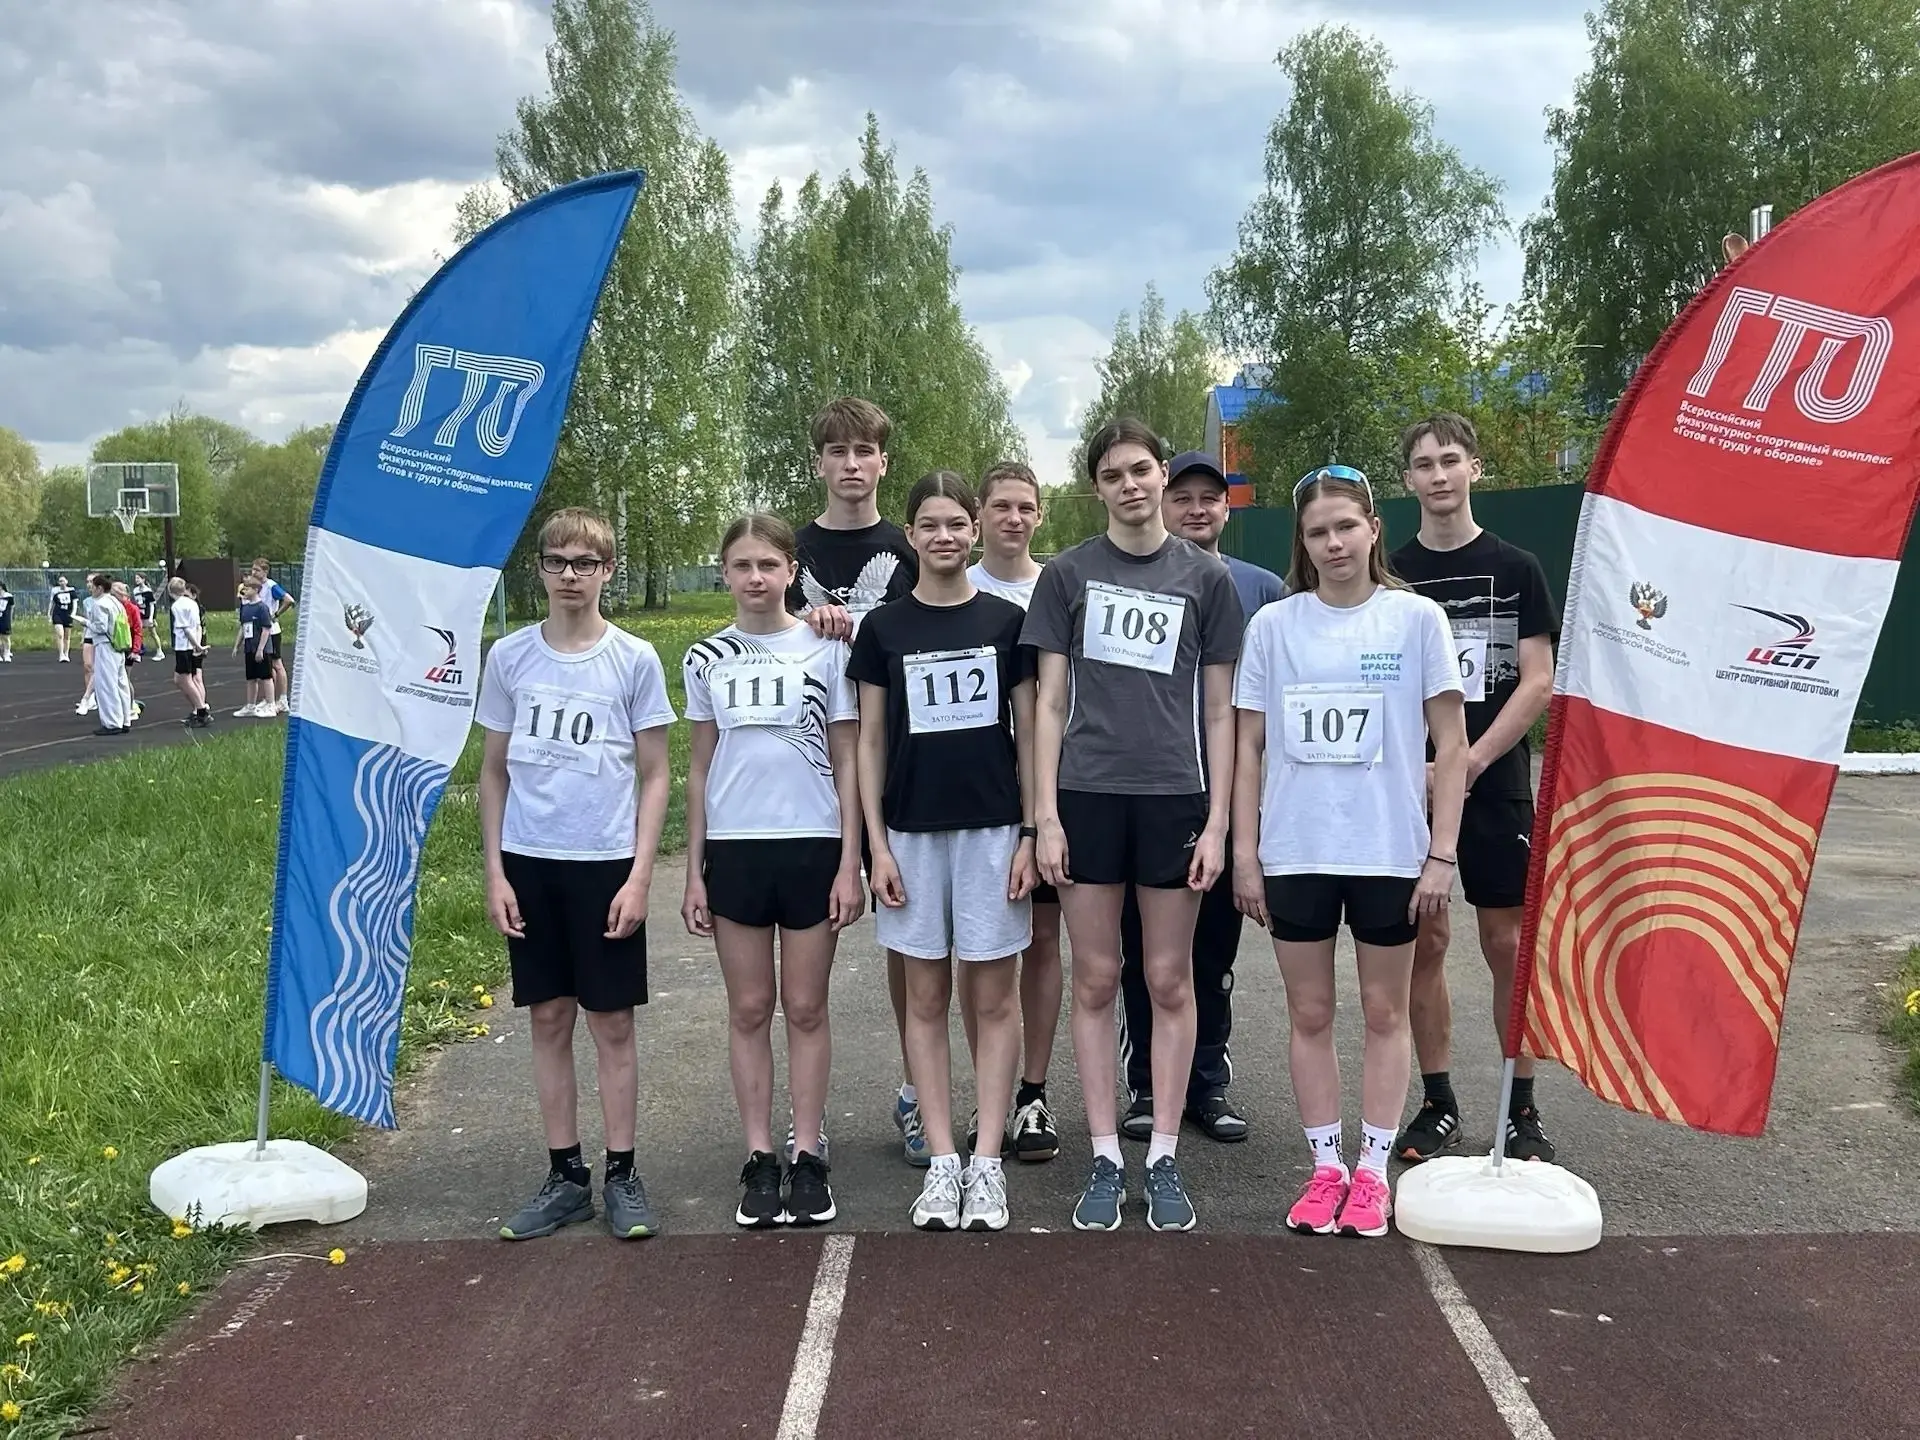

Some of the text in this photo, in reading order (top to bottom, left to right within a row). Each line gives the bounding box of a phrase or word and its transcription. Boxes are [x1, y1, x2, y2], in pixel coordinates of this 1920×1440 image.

[1679, 399, 1763, 430] Всероссийский
[380, 439, 452, 463] Всероссийский
[1673, 425, 1824, 467] «Готов к труду и обороне»
[1675, 413, 1893, 466] физкультурно-спортивный комплекс
[414, 472, 442, 487] труду
[491, 478, 533, 491] комплекс
[1098, 603, 1169, 645] 108
[1360, 653, 1403, 661] МАСТЕР
[1656, 643, 1688, 658] СПОРТА
[1745, 647, 1821, 670] ЦСП
[424, 666, 462, 684] ЦСП
[1360, 663, 1401, 671] БРАССА
[724, 675, 788, 710] 111
[920, 667, 988, 707] 112
[1715, 669, 1740, 681] ЦЕНТР
[1740, 673, 1790, 689] СПОРТИВНОЙ
[1790, 680, 1839, 698] ПОДГОТОВКИ
[525, 703, 594, 745] 110
[1298, 707, 1370, 743] 107
